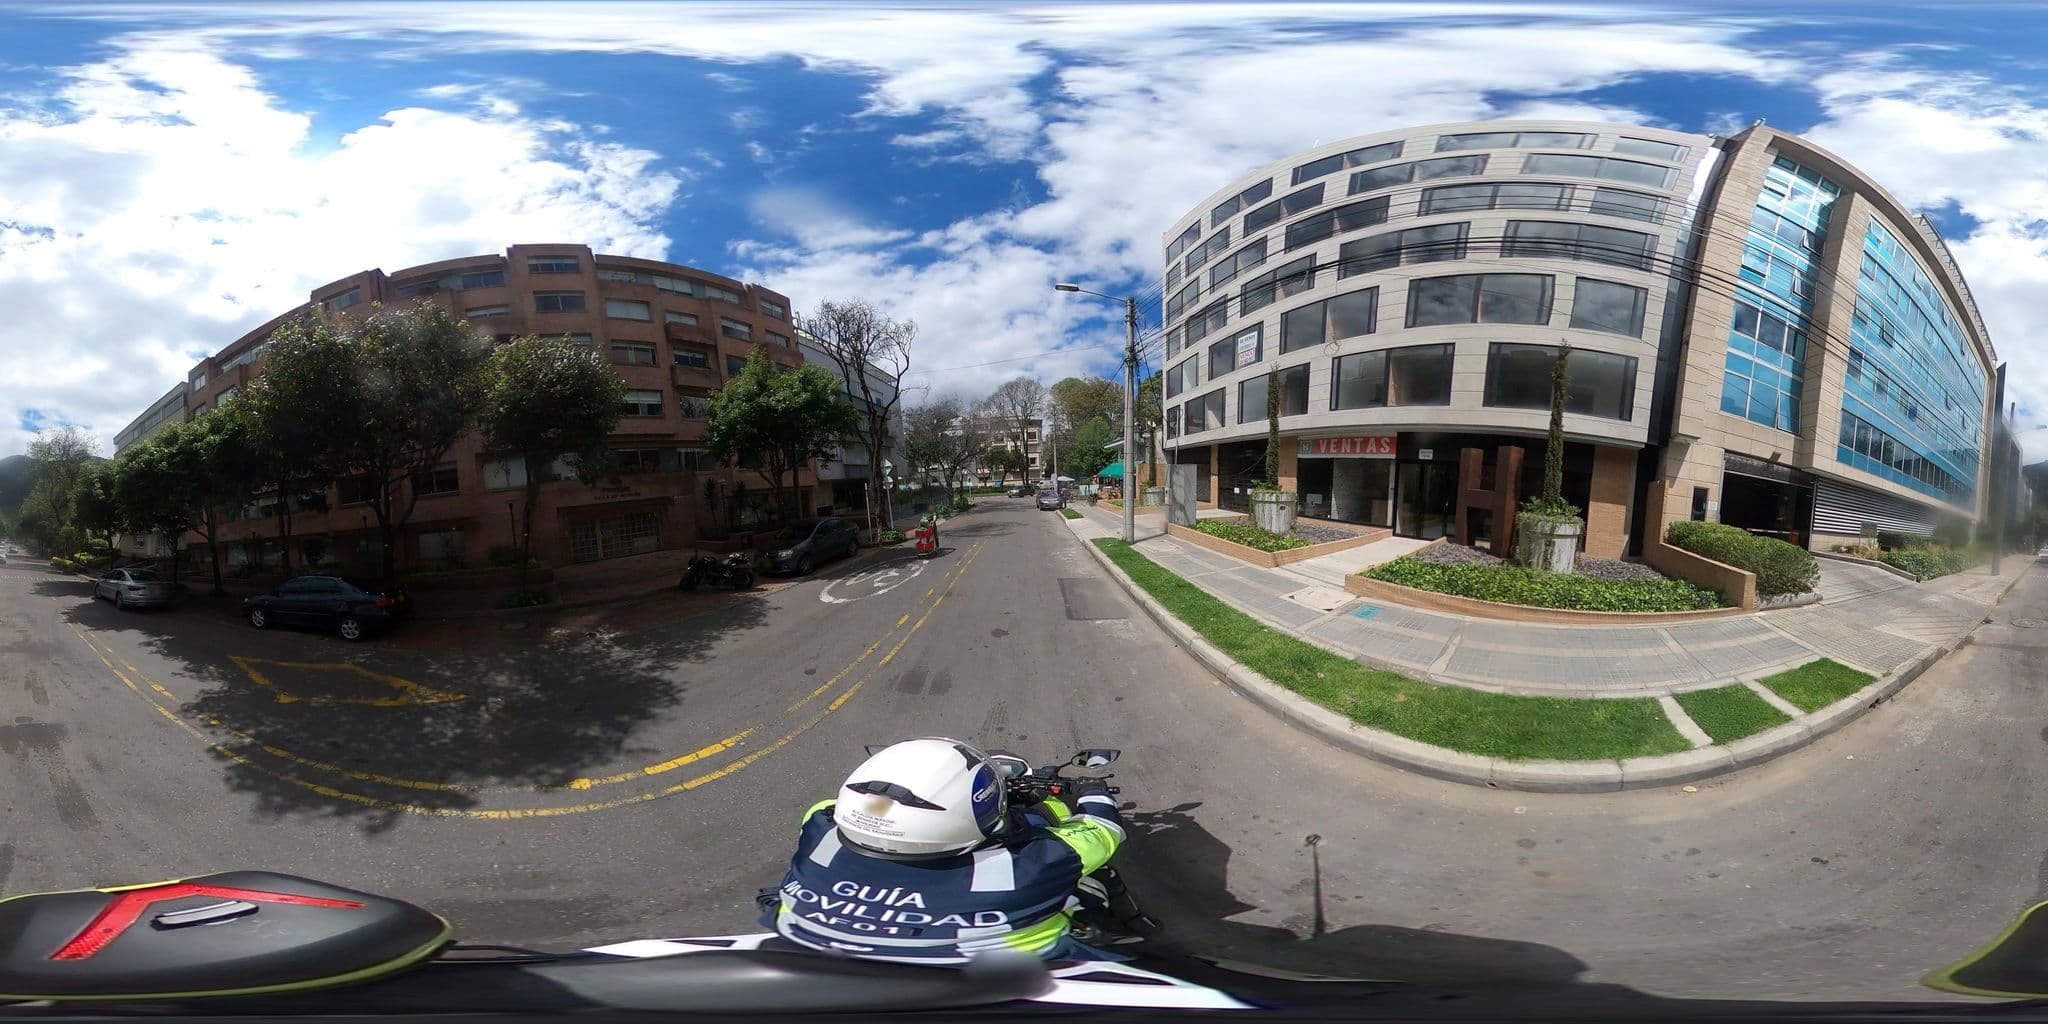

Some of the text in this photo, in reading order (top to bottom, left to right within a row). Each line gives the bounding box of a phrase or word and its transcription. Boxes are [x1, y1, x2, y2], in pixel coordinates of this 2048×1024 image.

[1320, 437, 1391, 453] VENTAS
[783, 880, 1010, 928] MOVILIDAD
[831, 880, 927, 909] GUÍA
